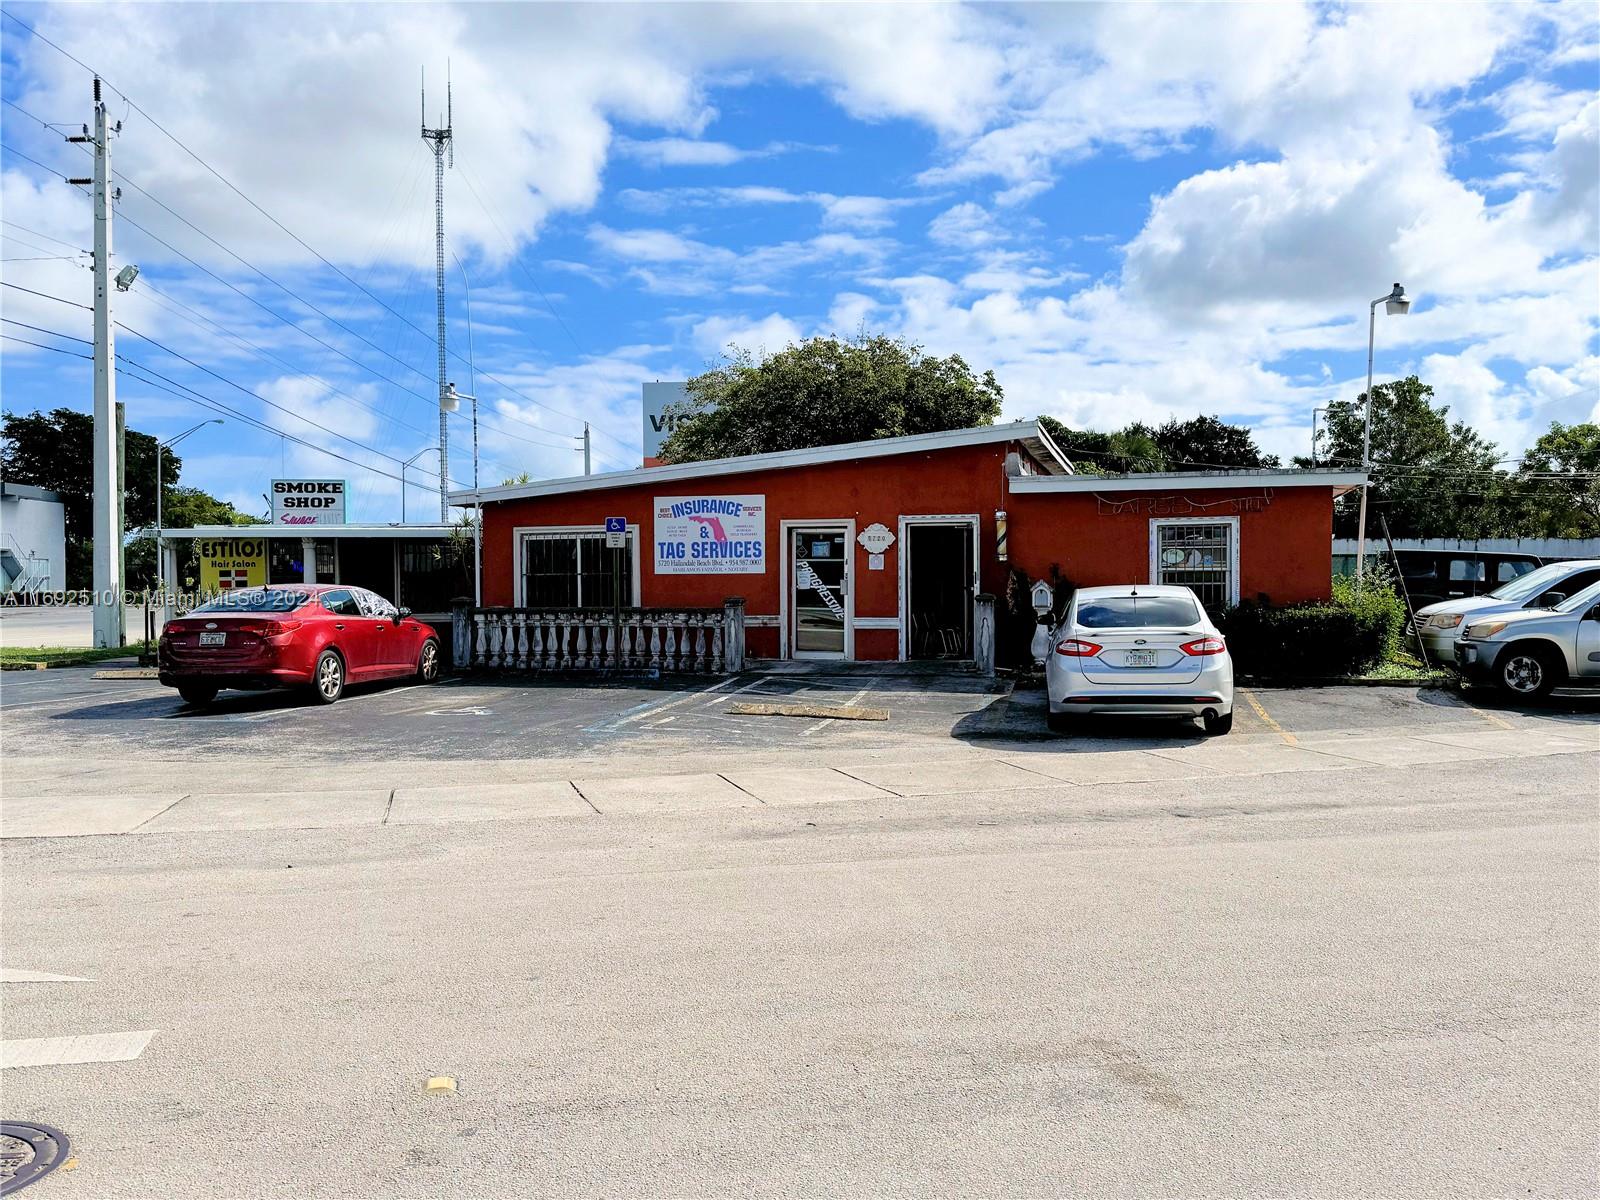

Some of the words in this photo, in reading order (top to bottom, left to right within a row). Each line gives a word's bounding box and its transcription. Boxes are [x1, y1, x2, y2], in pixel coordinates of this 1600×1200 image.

[274, 482, 343, 494] SMOKE
[283, 497, 336, 508] SHOP
[670, 499, 743, 519] INSURANCE
[699, 526, 710, 539] &
[201, 541, 264, 558] ESTILOS
[658, 542, 686, 560] TAG
[691, 541, 762, 559] SERVICES
[211, 560, 230, 568] Hair
[231, 560, 257, 568] Salon
[799, 560, 845, 620] PROGRESSIVE
